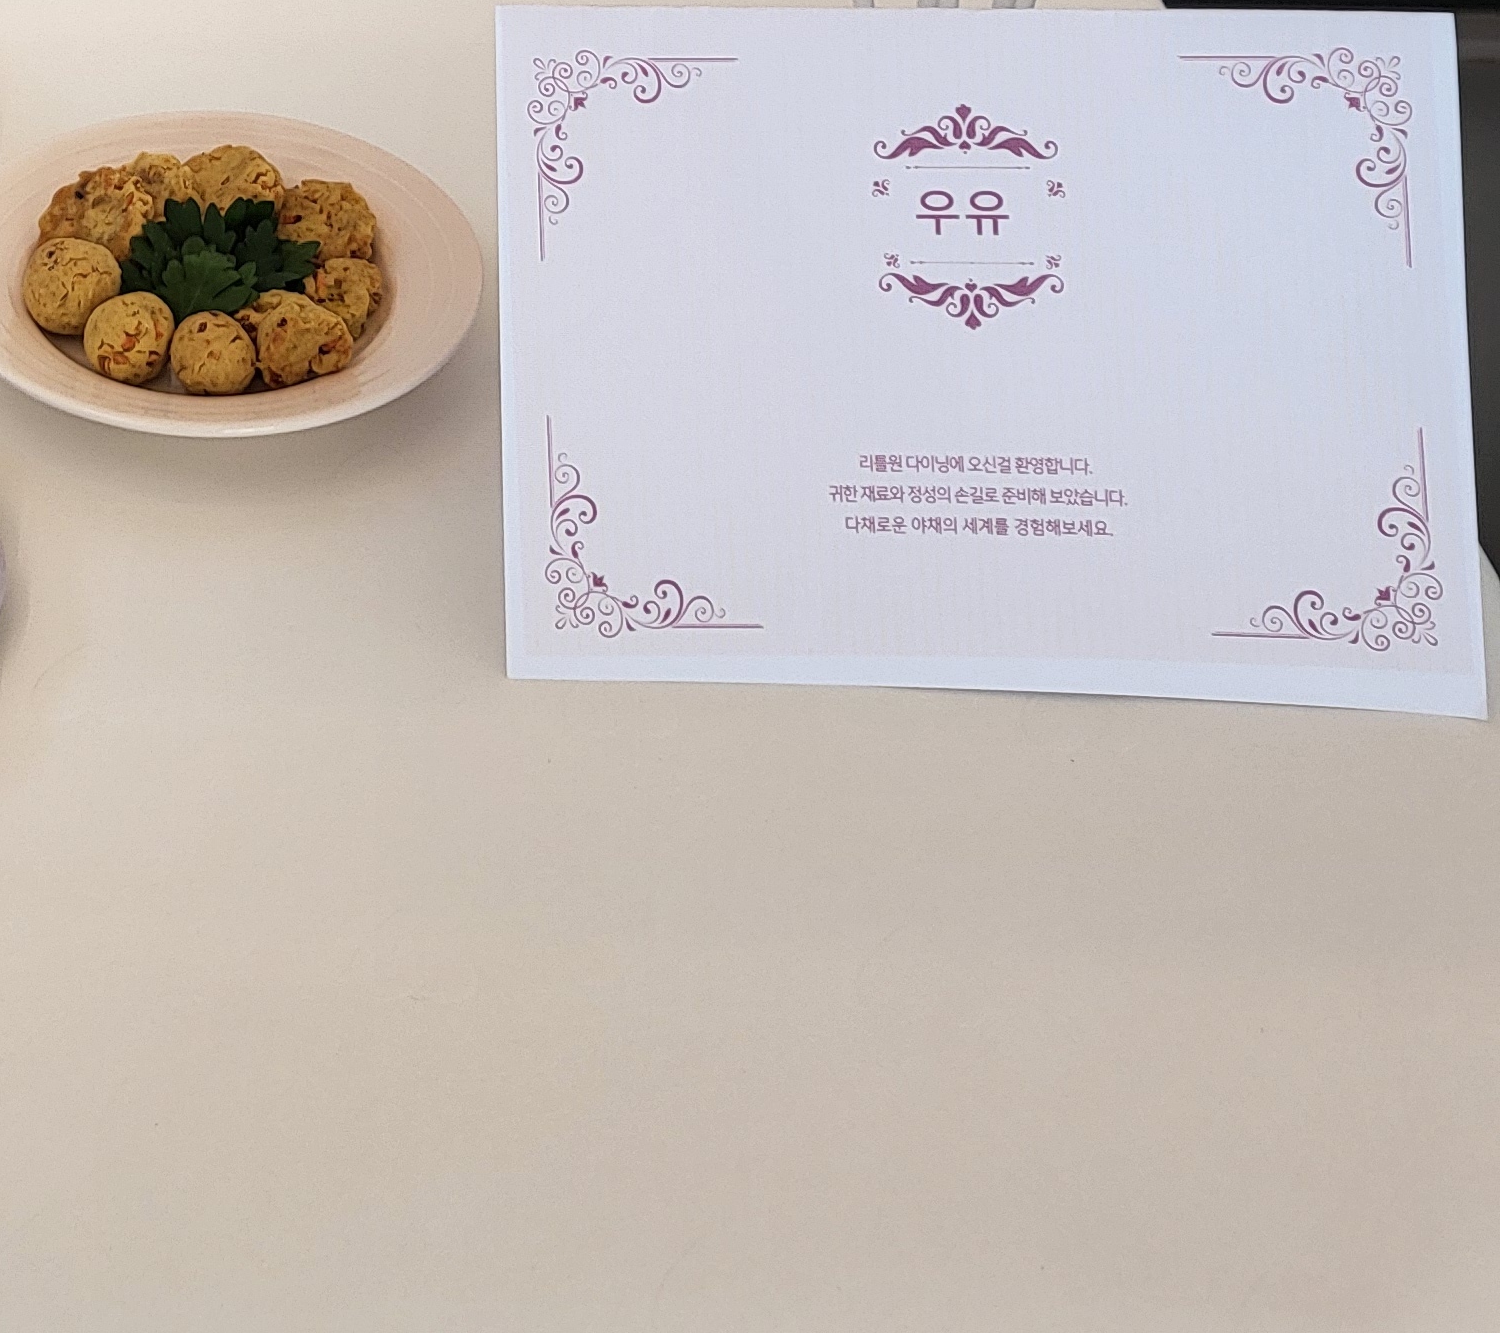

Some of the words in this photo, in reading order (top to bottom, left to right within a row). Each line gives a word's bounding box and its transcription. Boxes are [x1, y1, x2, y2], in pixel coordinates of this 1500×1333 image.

[916, 190, 1010, 236] 우유
[859, 454, 903, 473] 리틀원
[906, 454, 964, 474] 다이닝에
[967, 455, 1012, 475] 오신걸
[1014, 456, 1094, 476] 환영합니다.
[829, 484, 858, 503] 귀한
[861, 484, 905, 504] 재료와
[908, 485, 952, 504] 정성의
[954, 486, 999, 505] 손길로
[1001, 486, 1047, 506] 준비해
[1050, 488, 1129, 508] 보았습니다.
[845, 515, 907, 535] 다채로운
[911, 516, 958, 535] 야채의
[962, 516, 1010, 536] 세계를
[1014, 517, 1115, 538] 경험해보세요.
